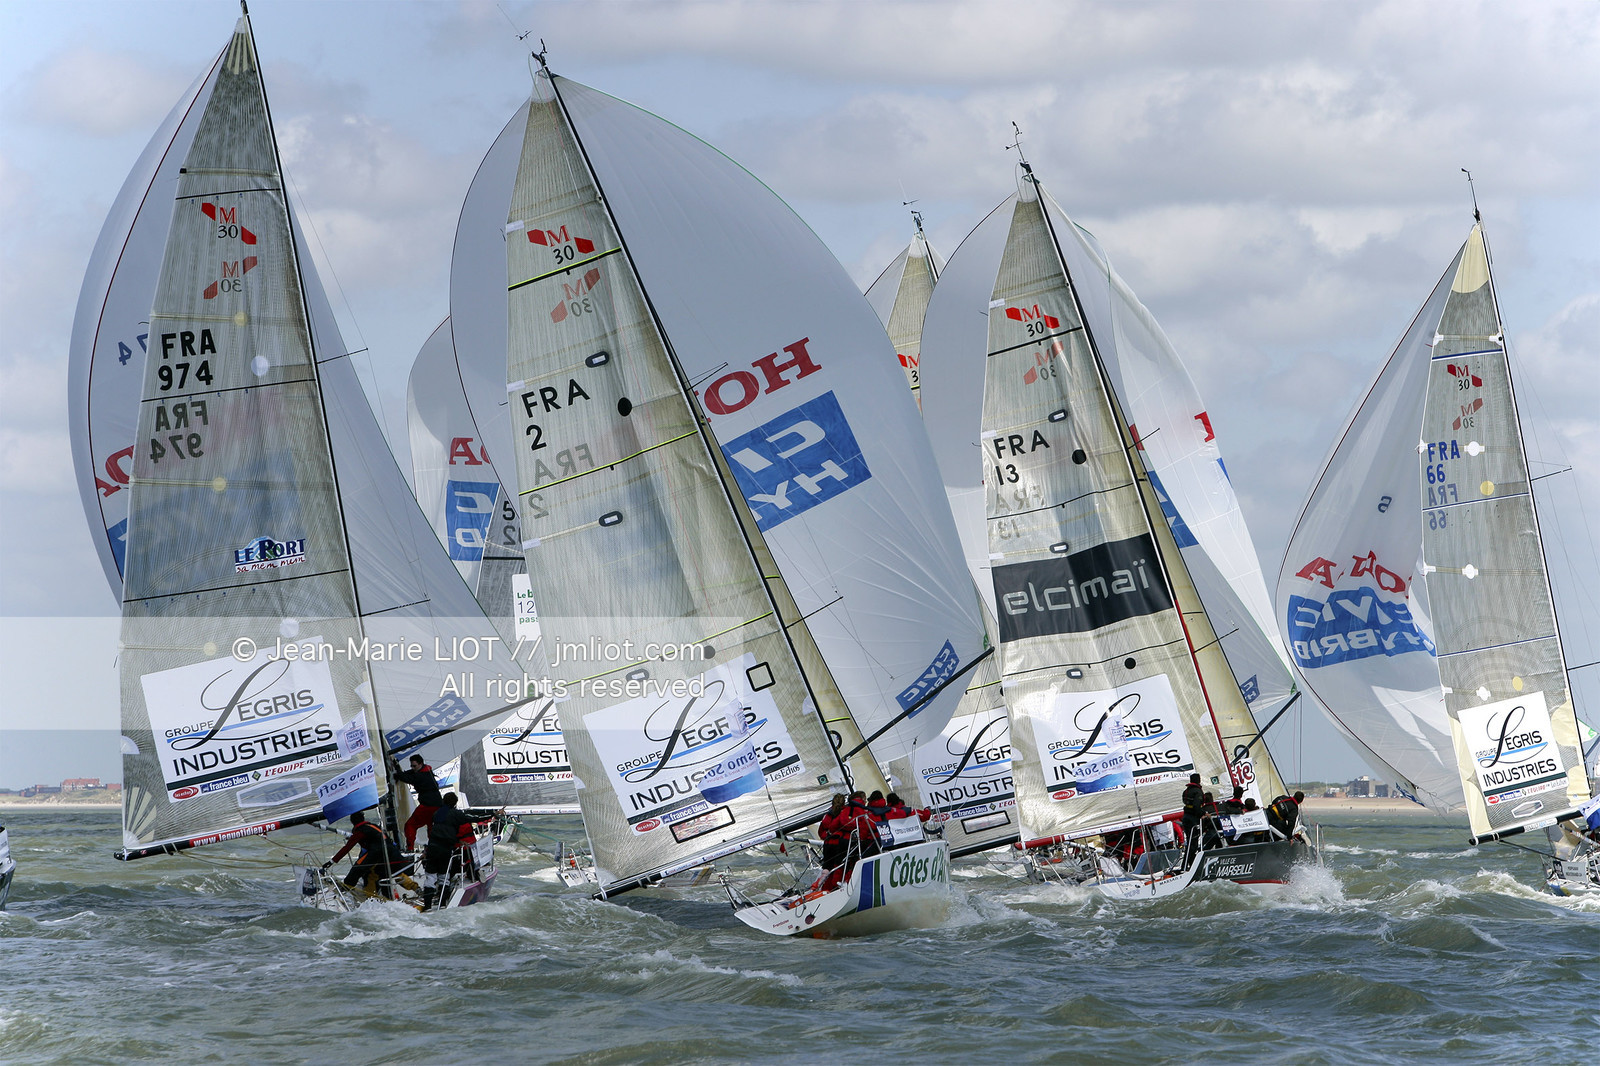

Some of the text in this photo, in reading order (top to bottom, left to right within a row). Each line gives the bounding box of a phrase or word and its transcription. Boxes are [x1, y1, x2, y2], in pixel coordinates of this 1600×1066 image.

[218, 206, 237, 224] M
[217, 225, 239, 239] 30
[546, 225, 571, 247] M
[553, 245, 575, 264] 30
[1021, 304, 1041, 322] M
[1027, 321, 1044, 337] 30
[161, 328, 217, 359] FRA
[158, 360, 214, 391] 974
[1456, 365, 1470, 378] M
[1458, 379, 1470, 391] 30
[521, 378, 591, 418] FRA
[526, 424, 547, 451] 2
[993, 430, 1050, 459] FRA
[1427, 440, 1460, 462] FRA
[995, 464, 1019, 485] 13
[1426, 464, 1446, 484] 66
[259, 538, 306, 560] PORT
[1002, 558, 1149, 616] elcimaï
[165, 720, 214, 738] GROUPE
[173, 723, 333, 777] INDUSTRIES
[1047, 738, 1087, 751] GROUPE
[1475, 747, 1497, 759] GROUPE
[492, 749, 568, 766] INDUST
[616, 751, 662, 772] GROUPE
[922, 763, 958, 776] GROUPE
[1483, 758, 1557, 787] INDUSTRIES
[209, 778, 232, 792] france
[231, 774, 249, 787] bleu
[930, 776, 1014, 805] INDUSTR
[669, 807, 693, 821] france
[691, 801, 708, 815] bleu
[890, 853, 929, 888] Côtes
[1216, 861, 1253, 878] MARSEILLE
